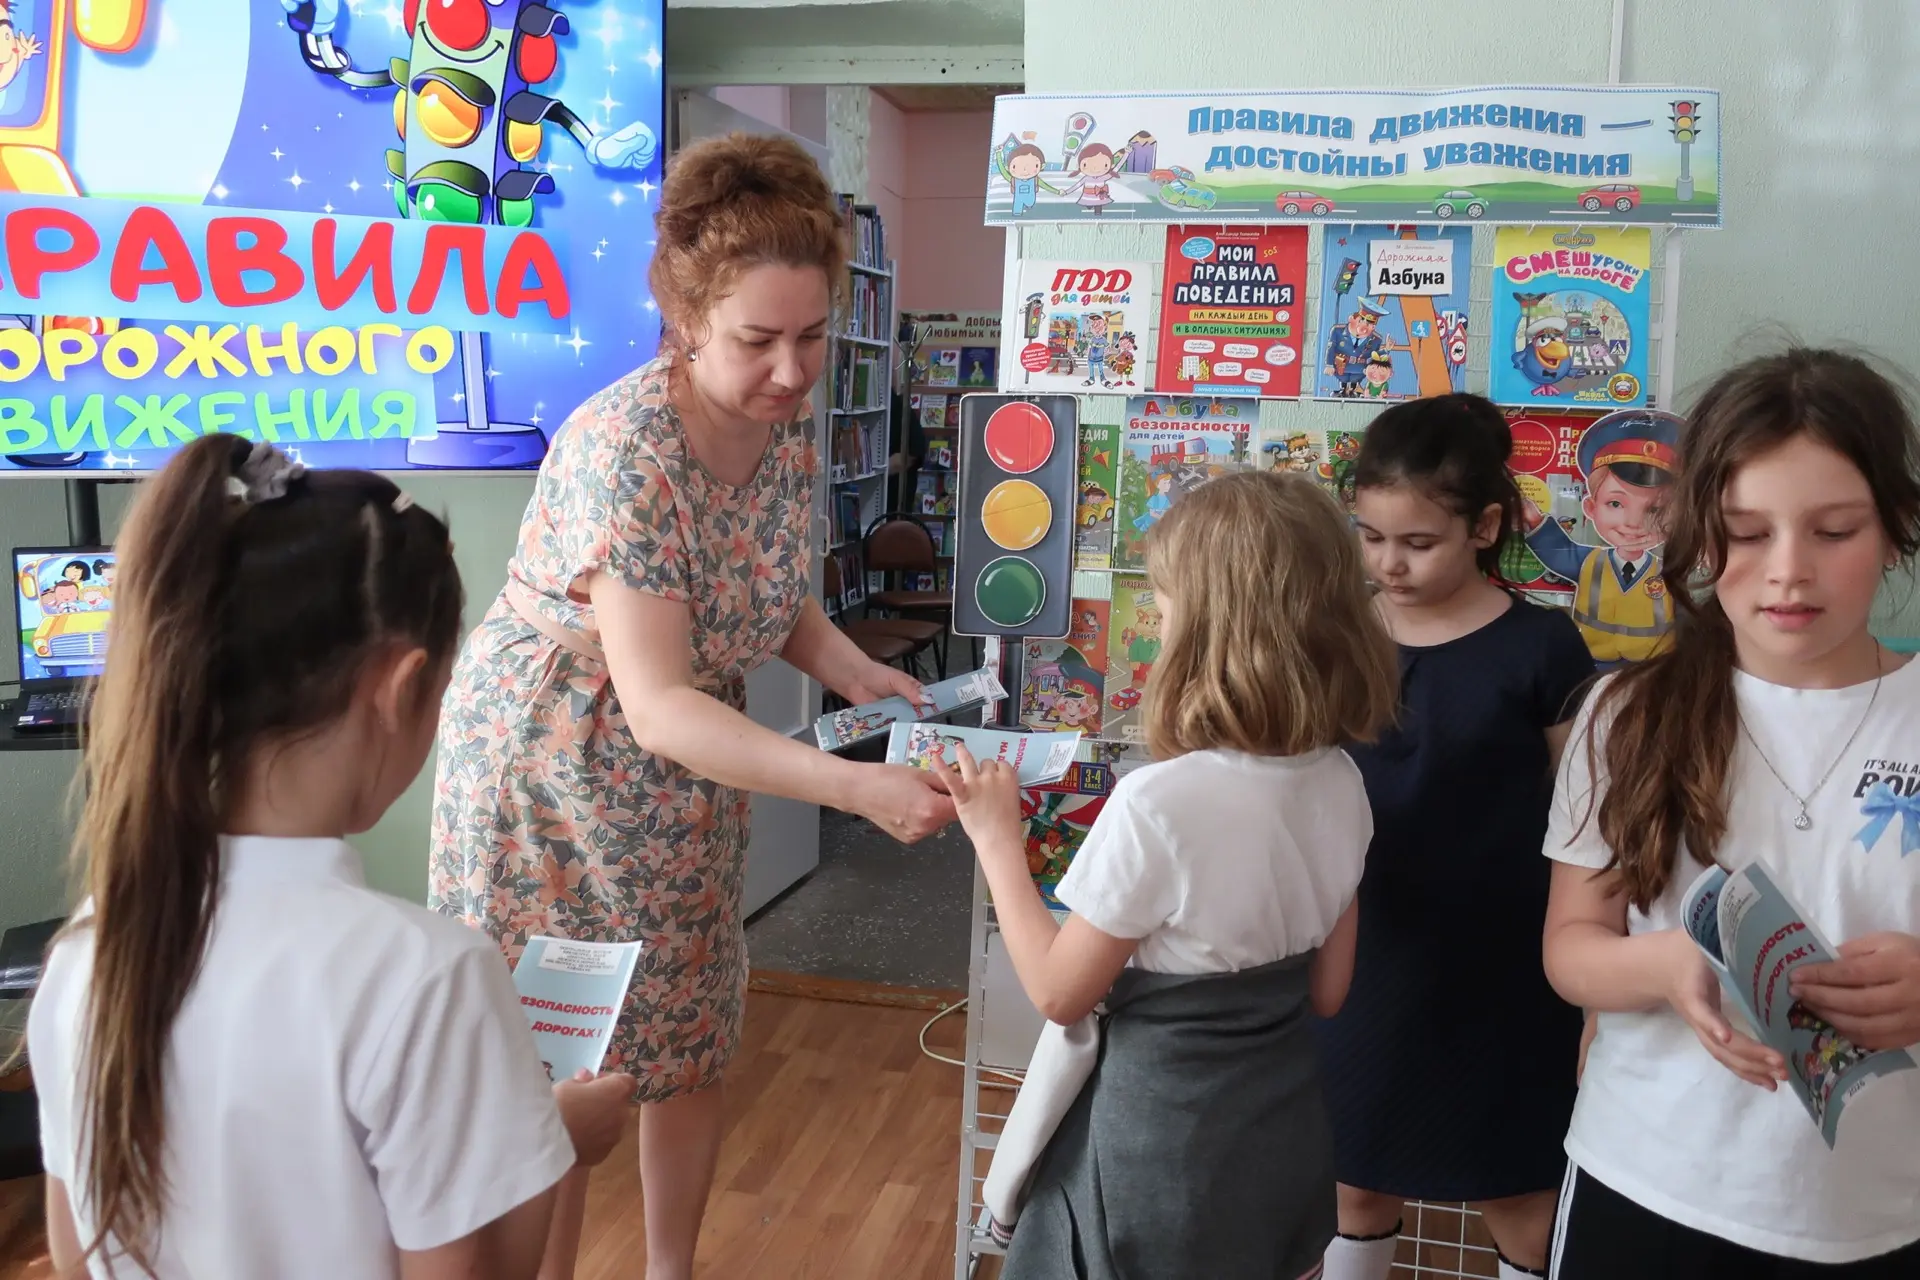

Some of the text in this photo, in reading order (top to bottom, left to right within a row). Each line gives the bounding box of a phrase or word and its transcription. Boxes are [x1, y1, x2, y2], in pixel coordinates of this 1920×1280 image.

[1187, 105, 1354, 141] Правила
[1369, 102, 1585, 144] движения
[1204, 139, 1633, 178] достойны уважения
[1218, 246, 1254, 261] МОИ
[1263, 246, 1278, 258] SOS
[1377, 249, 1448, 266] Дорожная
[0, 206, 571, 319] РАВИЛА
[1050, 268, 1132, 292] ПДД
[1193, 265, 1276, 281] ПРАВИЛА
[1378, 268, 1445, 290] Азбука
[1558, 267, 1636, 290] НА ДОРОГЕ
[1050, 292, 1131, 306] для детей
[1176, 284, 1291, 304] ПОВЕДЕНИЯ
[1193, 311, 1269, 320] НА КАЖДЫЙ ДЕНЬ
[1192, 325, 1232, 334] ОПАСНЫХ
[1234, 327, 1287, 335] СИТУАЦИЯХ
[1143, 400, 1240, 419] Азбука
[1129, 418, 1251, 433] безопасности
[1129, 432, 1185, 441] для детей
[1863, 759, 1920, 775] IT'S ALL A
[1085, 768, 1101, 783] 3-4
[519, 995, 614, 1016] ЕЗОПАСНОСТЬ
